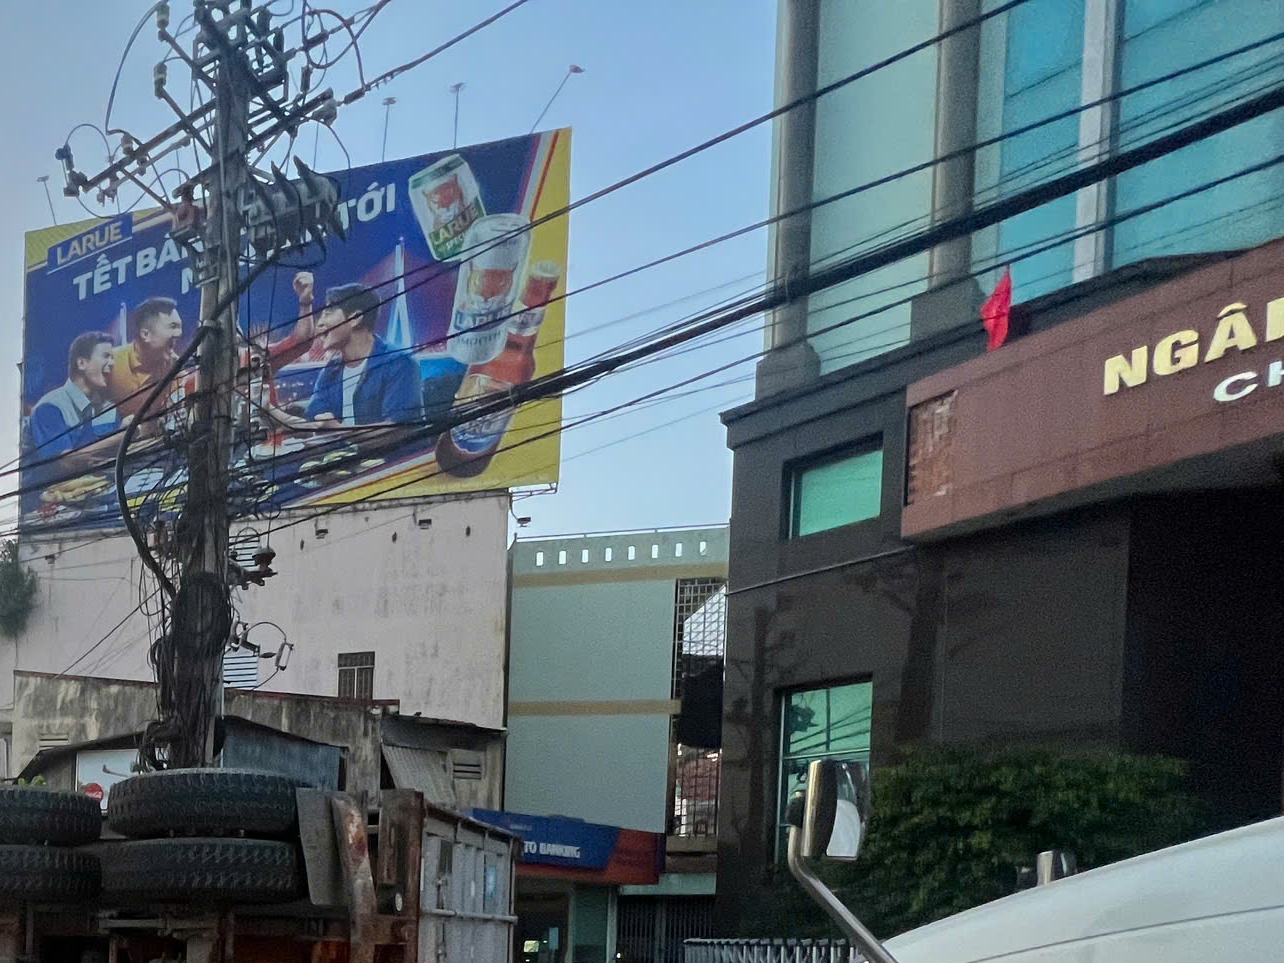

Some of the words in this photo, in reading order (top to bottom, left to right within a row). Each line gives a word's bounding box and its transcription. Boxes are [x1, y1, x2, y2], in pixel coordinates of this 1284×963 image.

[56, 220, 122, 266] LARUE
[72, 253, 132, 301] TẾT
[337, 182, 396, 230] TỚI
